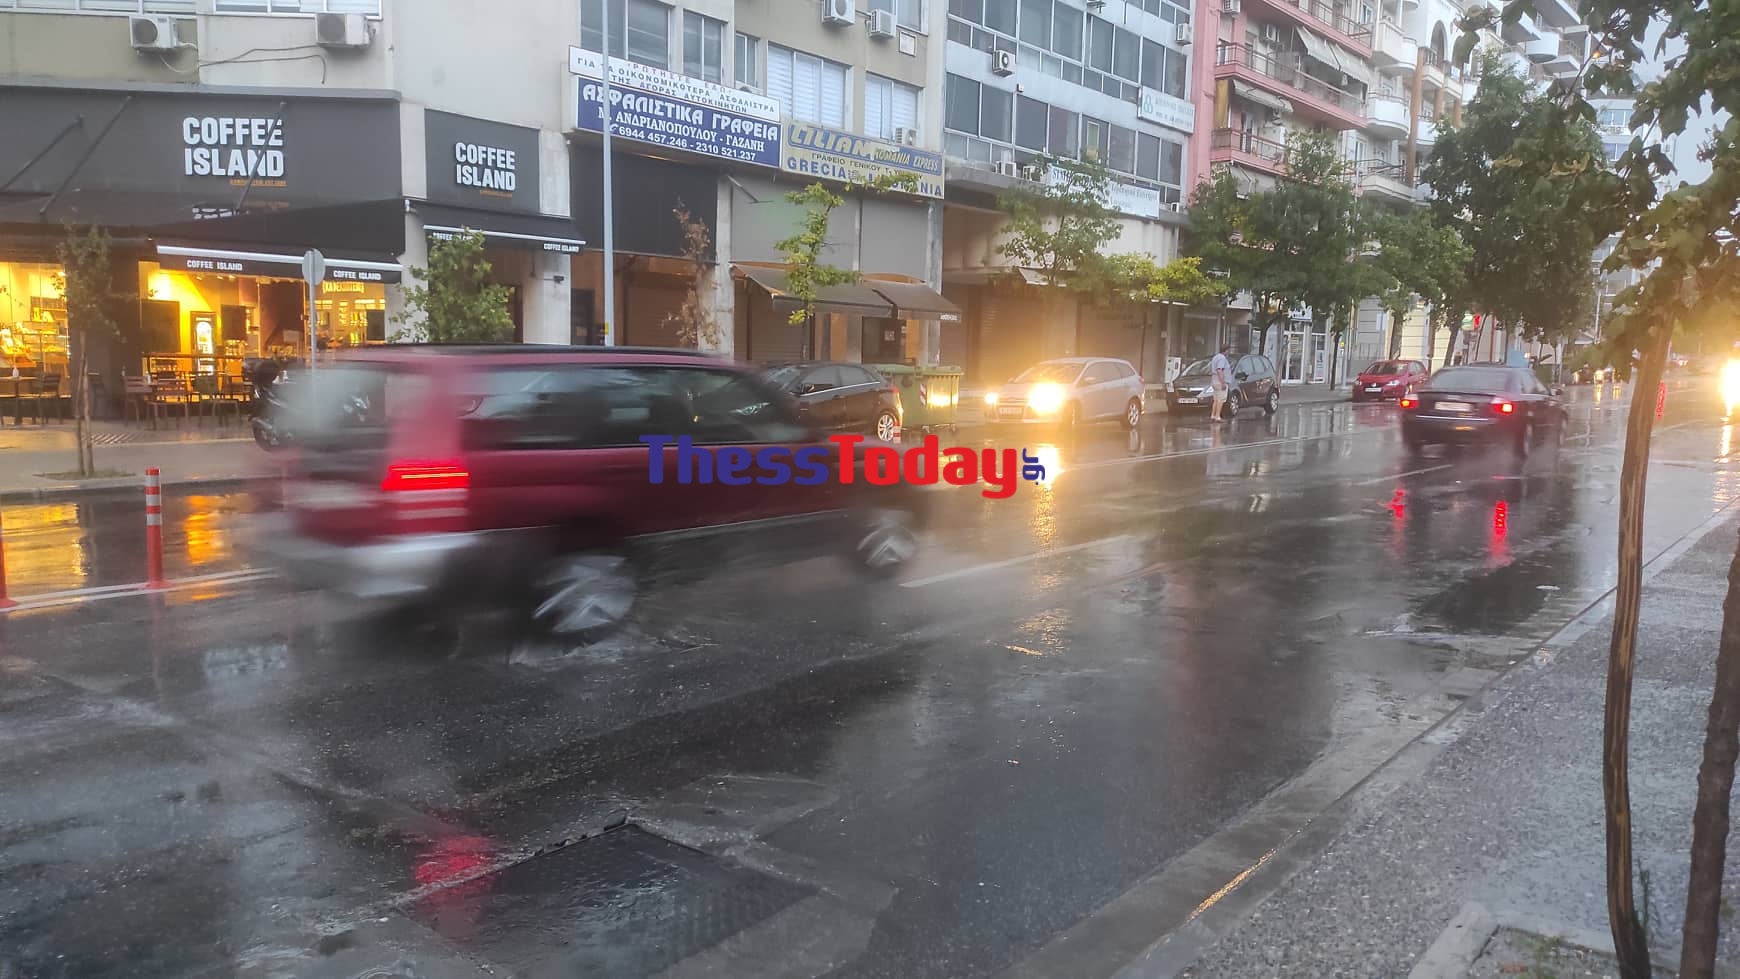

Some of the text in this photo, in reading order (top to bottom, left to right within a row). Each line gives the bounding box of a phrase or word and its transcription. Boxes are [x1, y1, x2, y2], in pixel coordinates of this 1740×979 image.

[577, 57, 596, 69] ΓΙΑ
[618, 67, 711, 97] ΟΙΚΟΝΟΜΙΚΟΤΕΡΑ
[611, 74, 748, 113] ΤΗΣ ΑΓΟΡΑΣ ΑΥΤΟΚΙΝΗΤΩΝ
[582, 83, 778, 140] ΑΣΦΑΛΙΣΤΙΚΑ ΓΡΑΦΕΙΑ
[183, 117, 284, 146] COFFEE
[615, 111, 718, 142] ΑΝΔΡΙΑΝΟΠΟΥΛΟΥ
[726, 134, 765, 152] ΓΑΖΑΝΗ
[618, 126, 646, 140] 6944
[647, 132, 688, 148] 457.246
[695, 141, 719, 154] 2310
[721, 146, 757, 161] 521.237
[184, 147, 284, 177] ISLAND
[455, 142, 516, 171] COFFEE
[787, 156, 847, 180] GRECIA
[811, 152, 846, 166] ΓΡΑΦΕΙΟ
[456, 164, 517, 192] ISLAND
[543, 243, 561, 251] COFFEE
[186, 259, 243, 271] COFFEE ISLAND
[333, 270, 382, 280] COFFEE ISLAND
